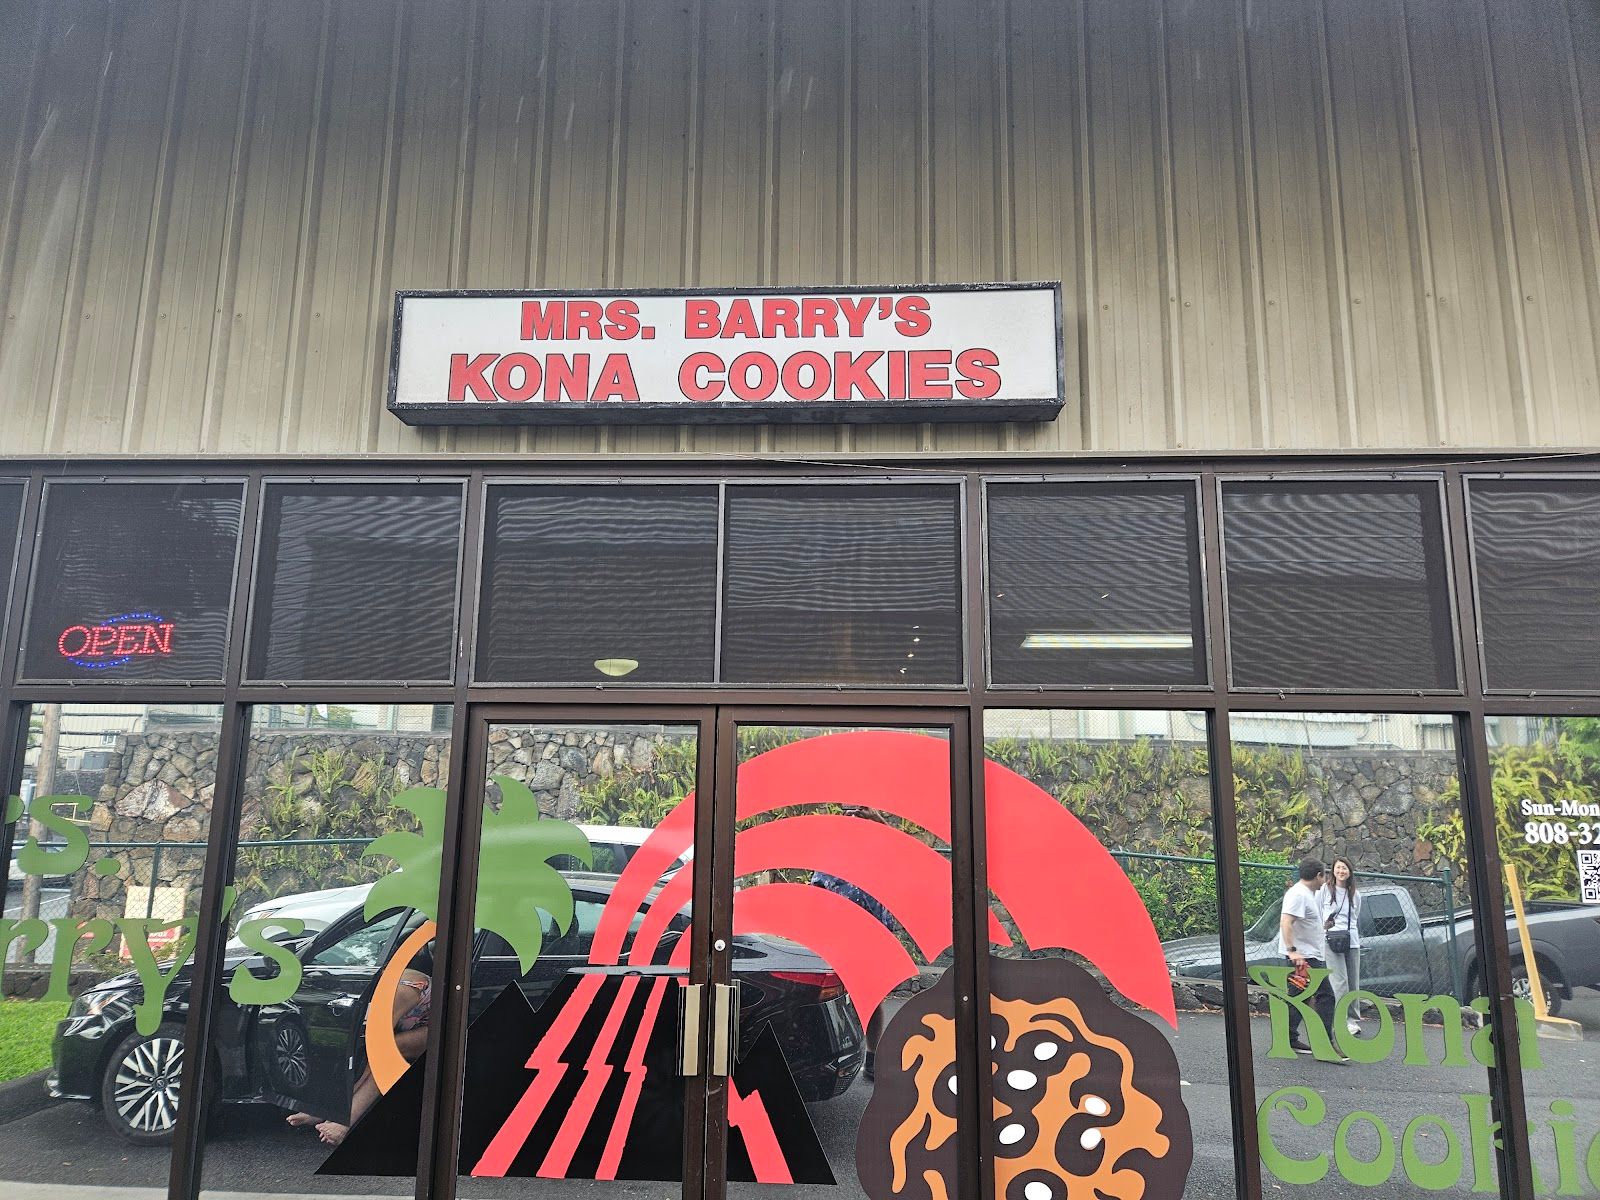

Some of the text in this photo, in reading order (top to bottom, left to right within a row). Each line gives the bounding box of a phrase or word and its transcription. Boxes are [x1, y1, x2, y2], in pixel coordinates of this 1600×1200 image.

[520, 296, 931, 341] MRS. BARRY'S
[448, 348, 1001, 402] KONA COOKIES
[57, 623, 175, 657] OPEN
[1248, 966, 1545, 1069] Kona
[1256, 1085, 1600, 1198] Cooki
